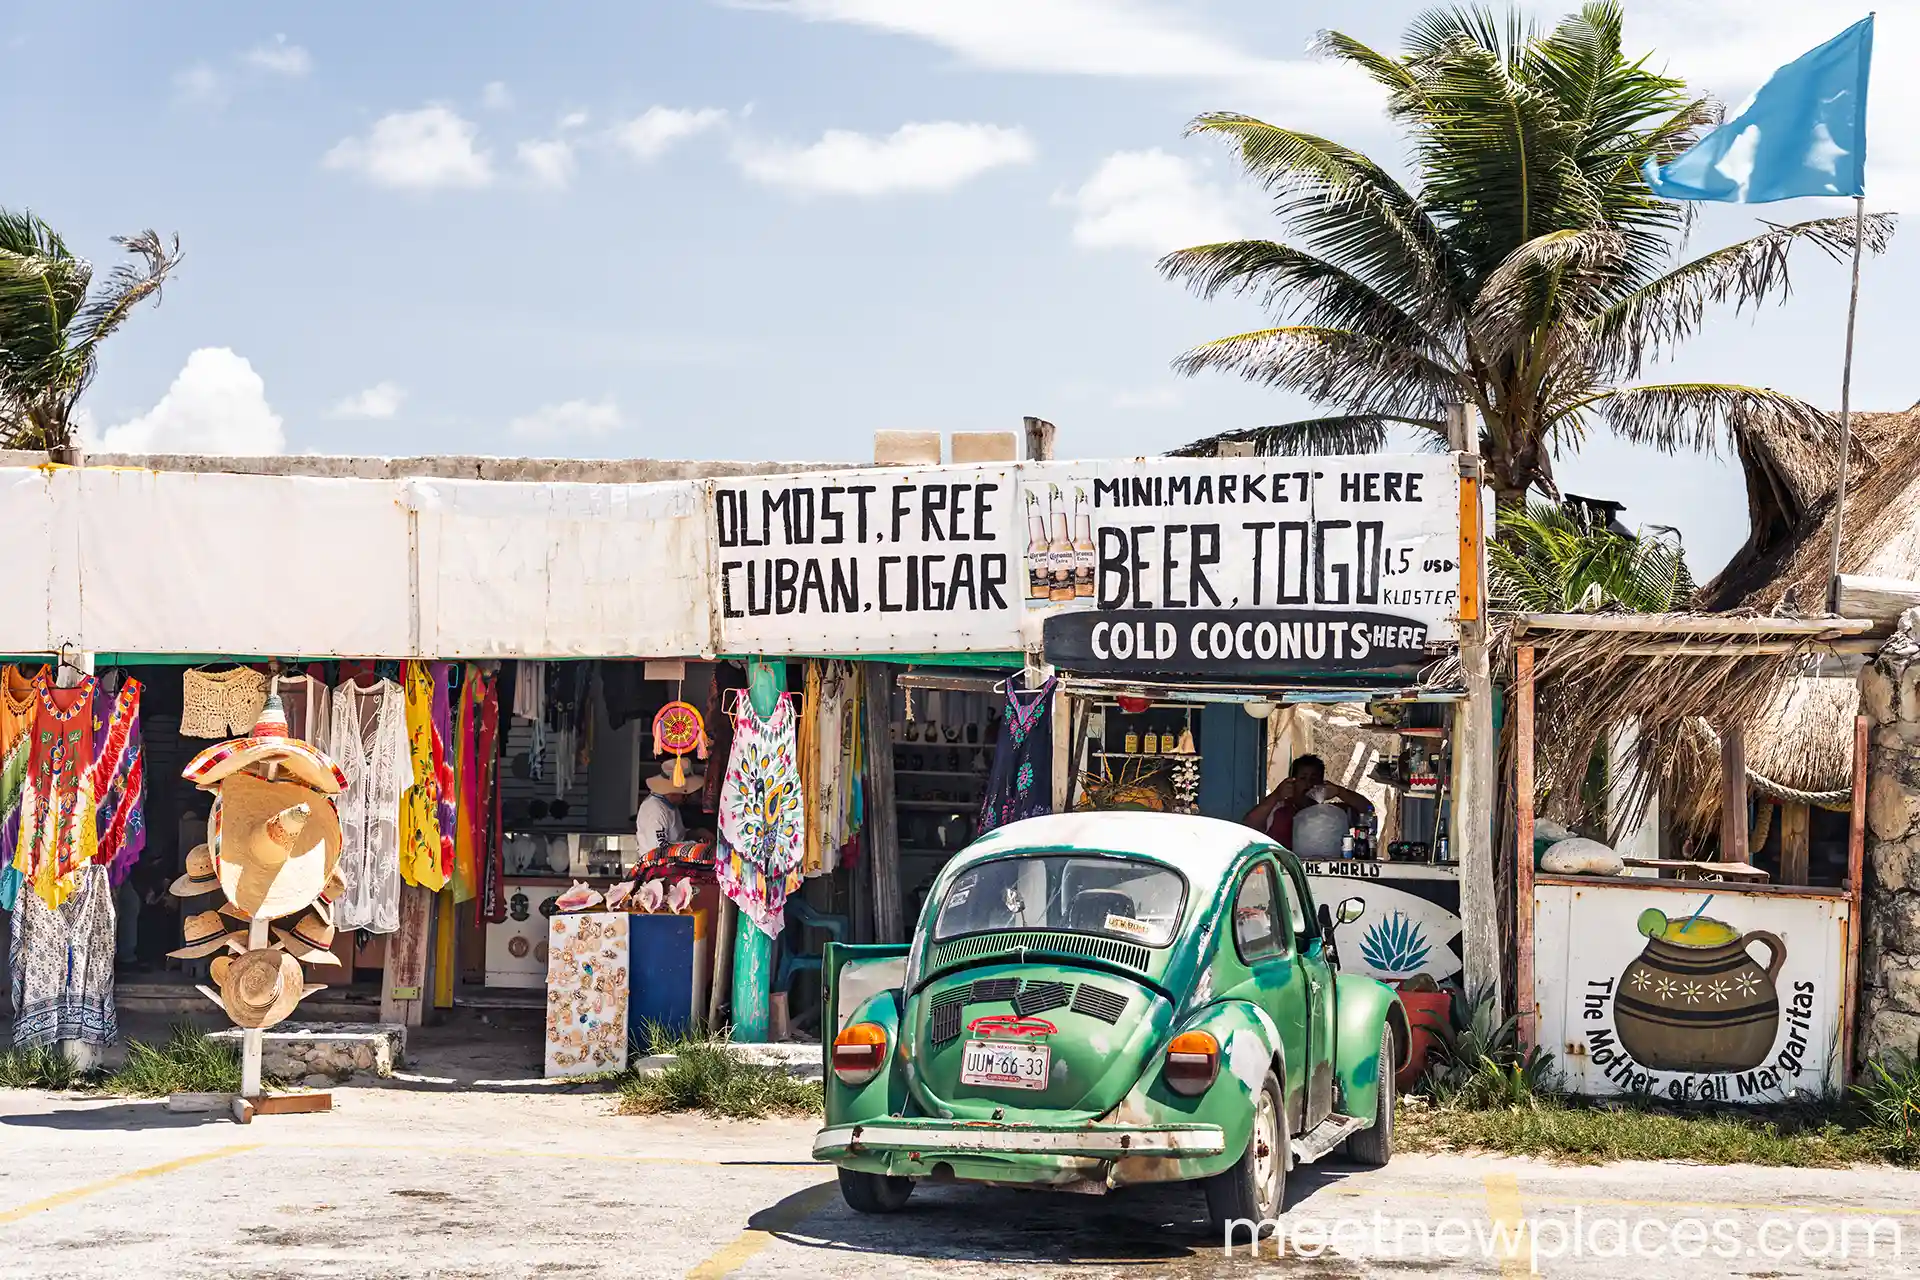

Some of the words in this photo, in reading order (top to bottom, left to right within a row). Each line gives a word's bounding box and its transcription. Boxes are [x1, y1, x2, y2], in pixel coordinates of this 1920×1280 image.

[1340, 472, 1424, 502] HERE
[891, 484, 998, 542] FREE
[1242, 520, 1384, 605] TOGO
[1423, 560, 1454, 573] USD
[879, 553, 1009, 612] CIGAR
[1384, 589, 1456, 605] KLOSTER
[1091, 621, 1178, 660] COLD
[1190, 621, 1371, 660] COCONUTS
[1372, 624, 1427, 650] HERE
[1302, 861, 1322, 874] HE
[1329, 862, 1382, 878] WORLD
[1583, 976, 1615, 1020] The
[1735, 980, 1815, 1097] Margaritas
[967, 1052, 1043, 1076] UUM-66-33
[1585, 1028, 1660, 1097] Mother
[1668, 1075, 1694, 1100] of
[1700, 1075, 1729, 1100] all
